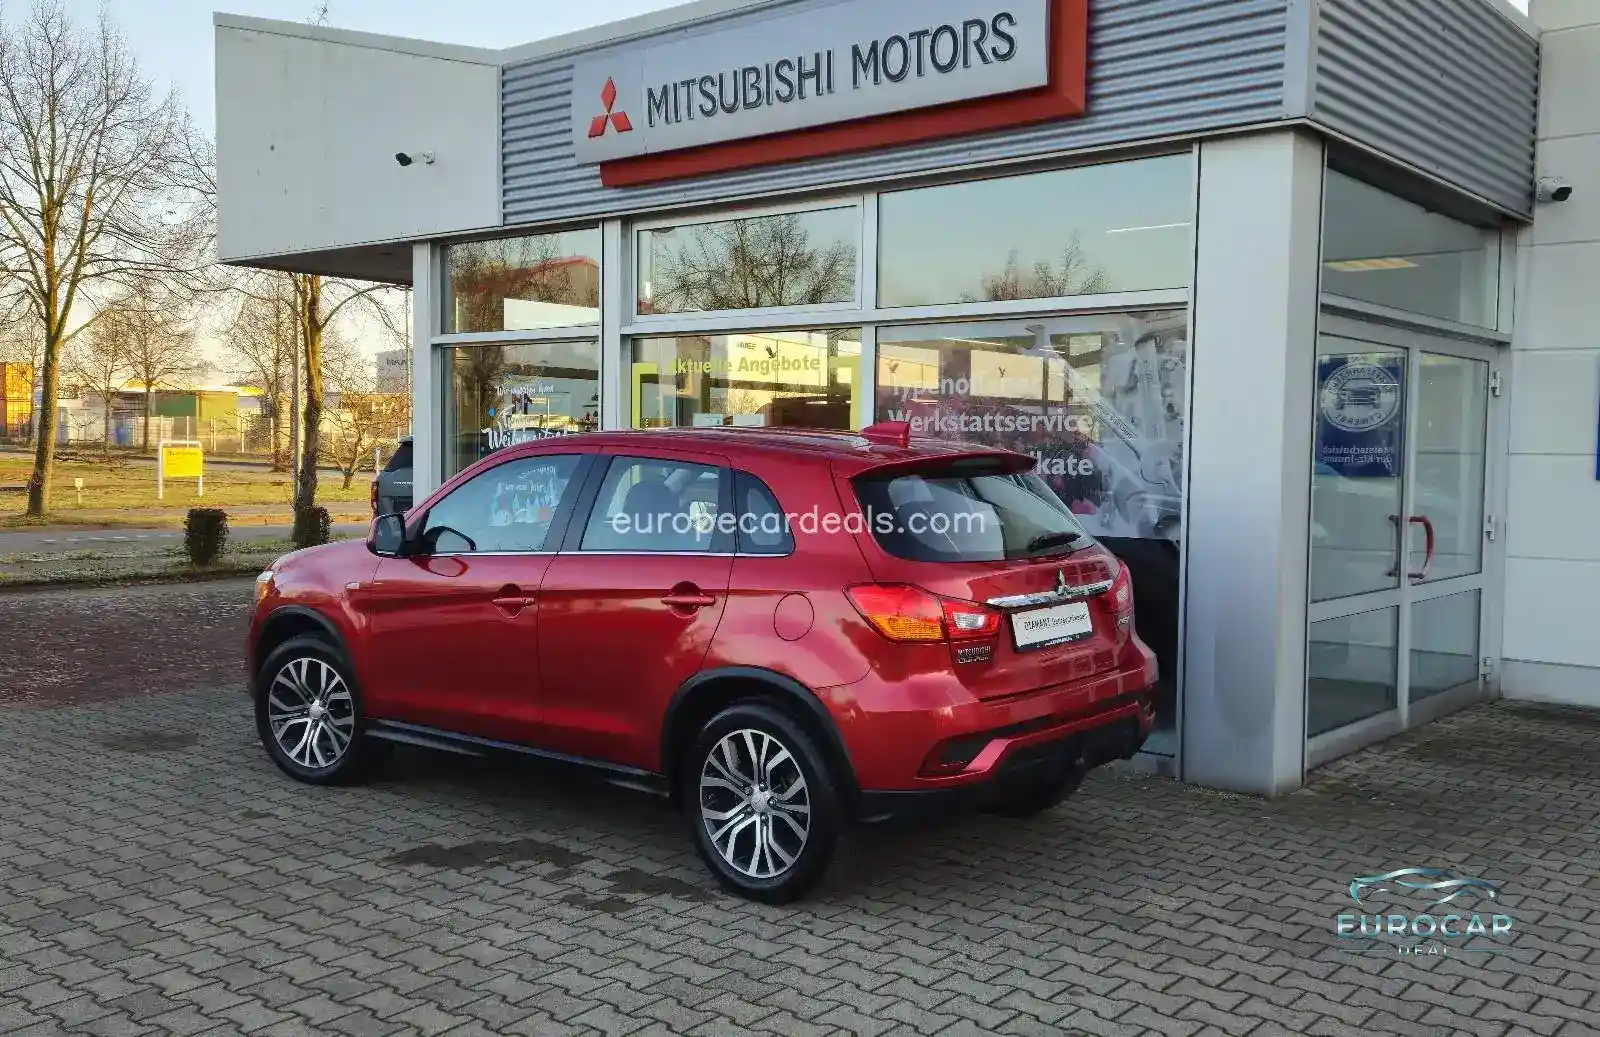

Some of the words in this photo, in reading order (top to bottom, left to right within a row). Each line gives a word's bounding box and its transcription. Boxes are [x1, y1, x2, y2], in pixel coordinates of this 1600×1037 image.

[646, 49, 834, 127] MITSUBISHI
[851, 11, 1018, 90] MOTORS
[737, 355, 821, 375] Angebote
[887, 406, 1093, 433] Werkstattservice
